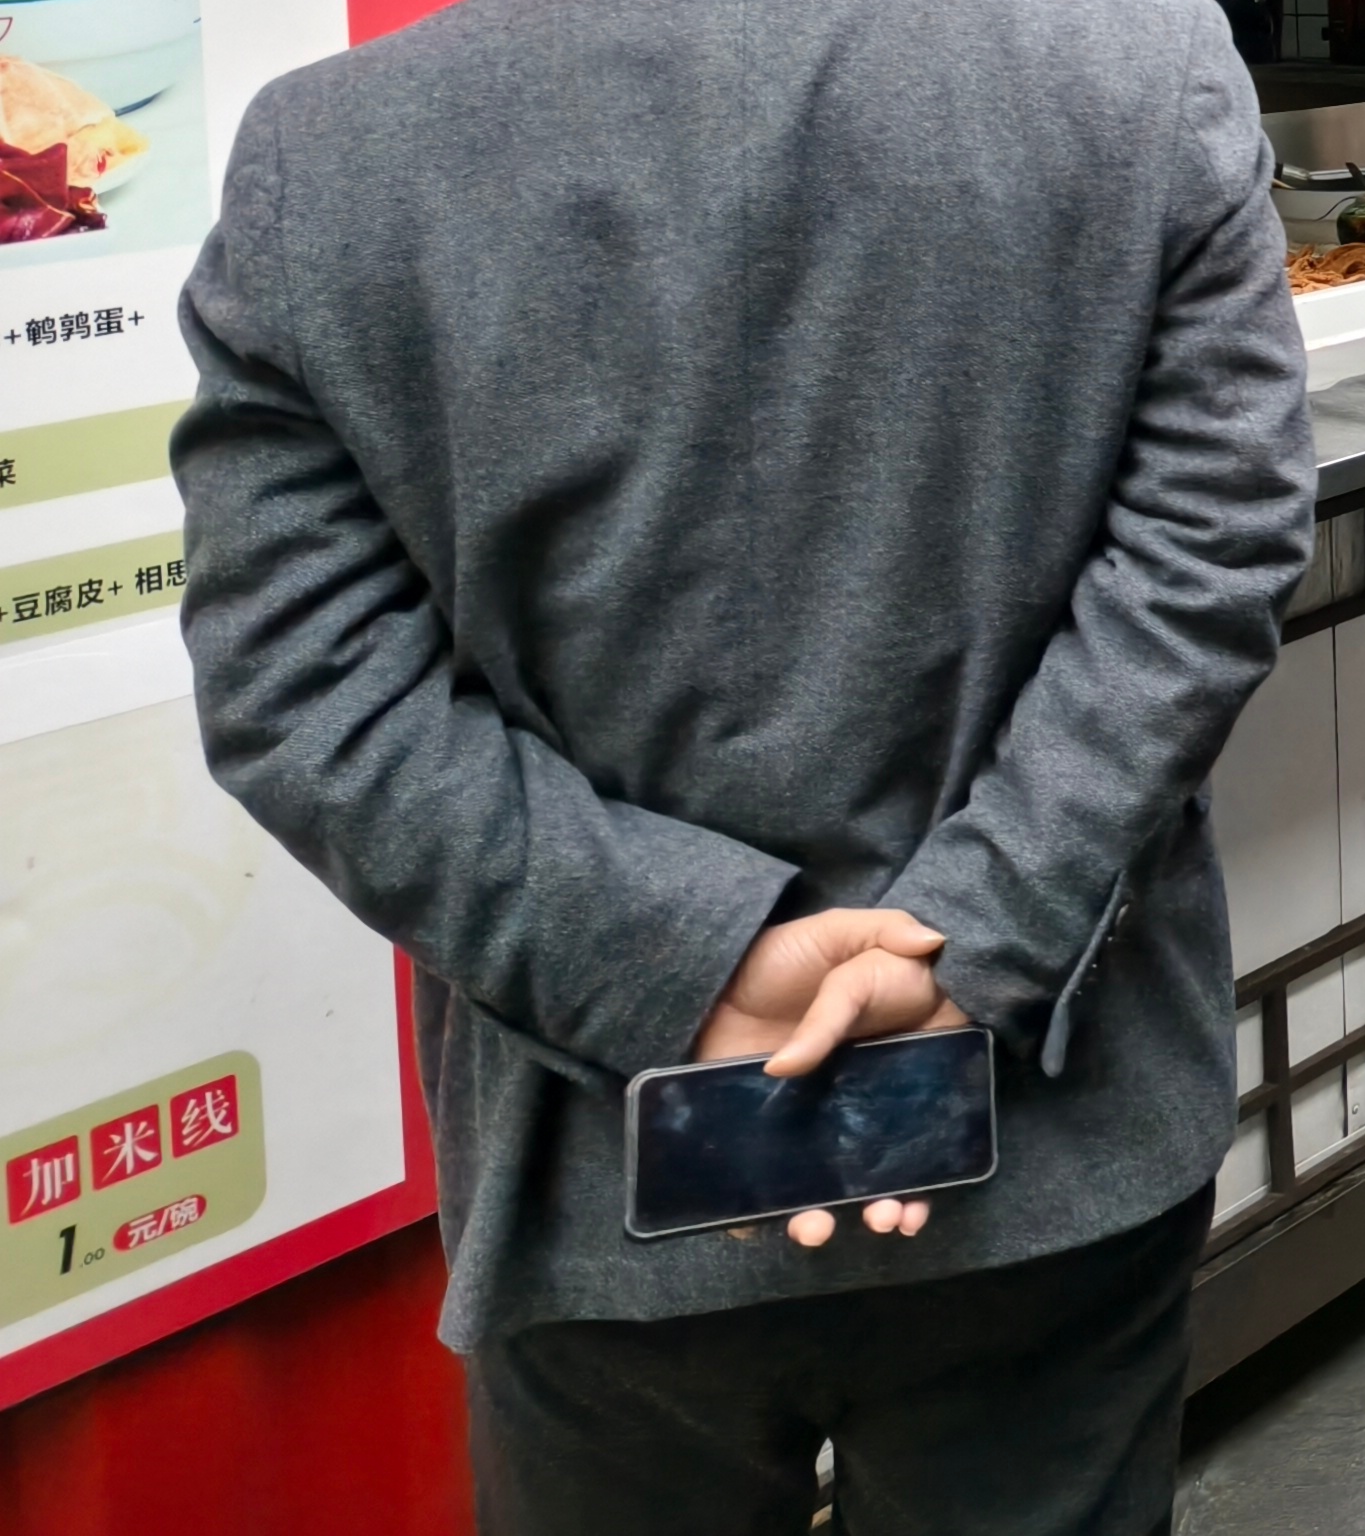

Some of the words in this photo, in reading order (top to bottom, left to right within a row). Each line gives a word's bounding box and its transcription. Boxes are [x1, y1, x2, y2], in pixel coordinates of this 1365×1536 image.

[20, 1089, 233, 1218] 加米线
[127, 1197, 200, 1249] 元/碗
